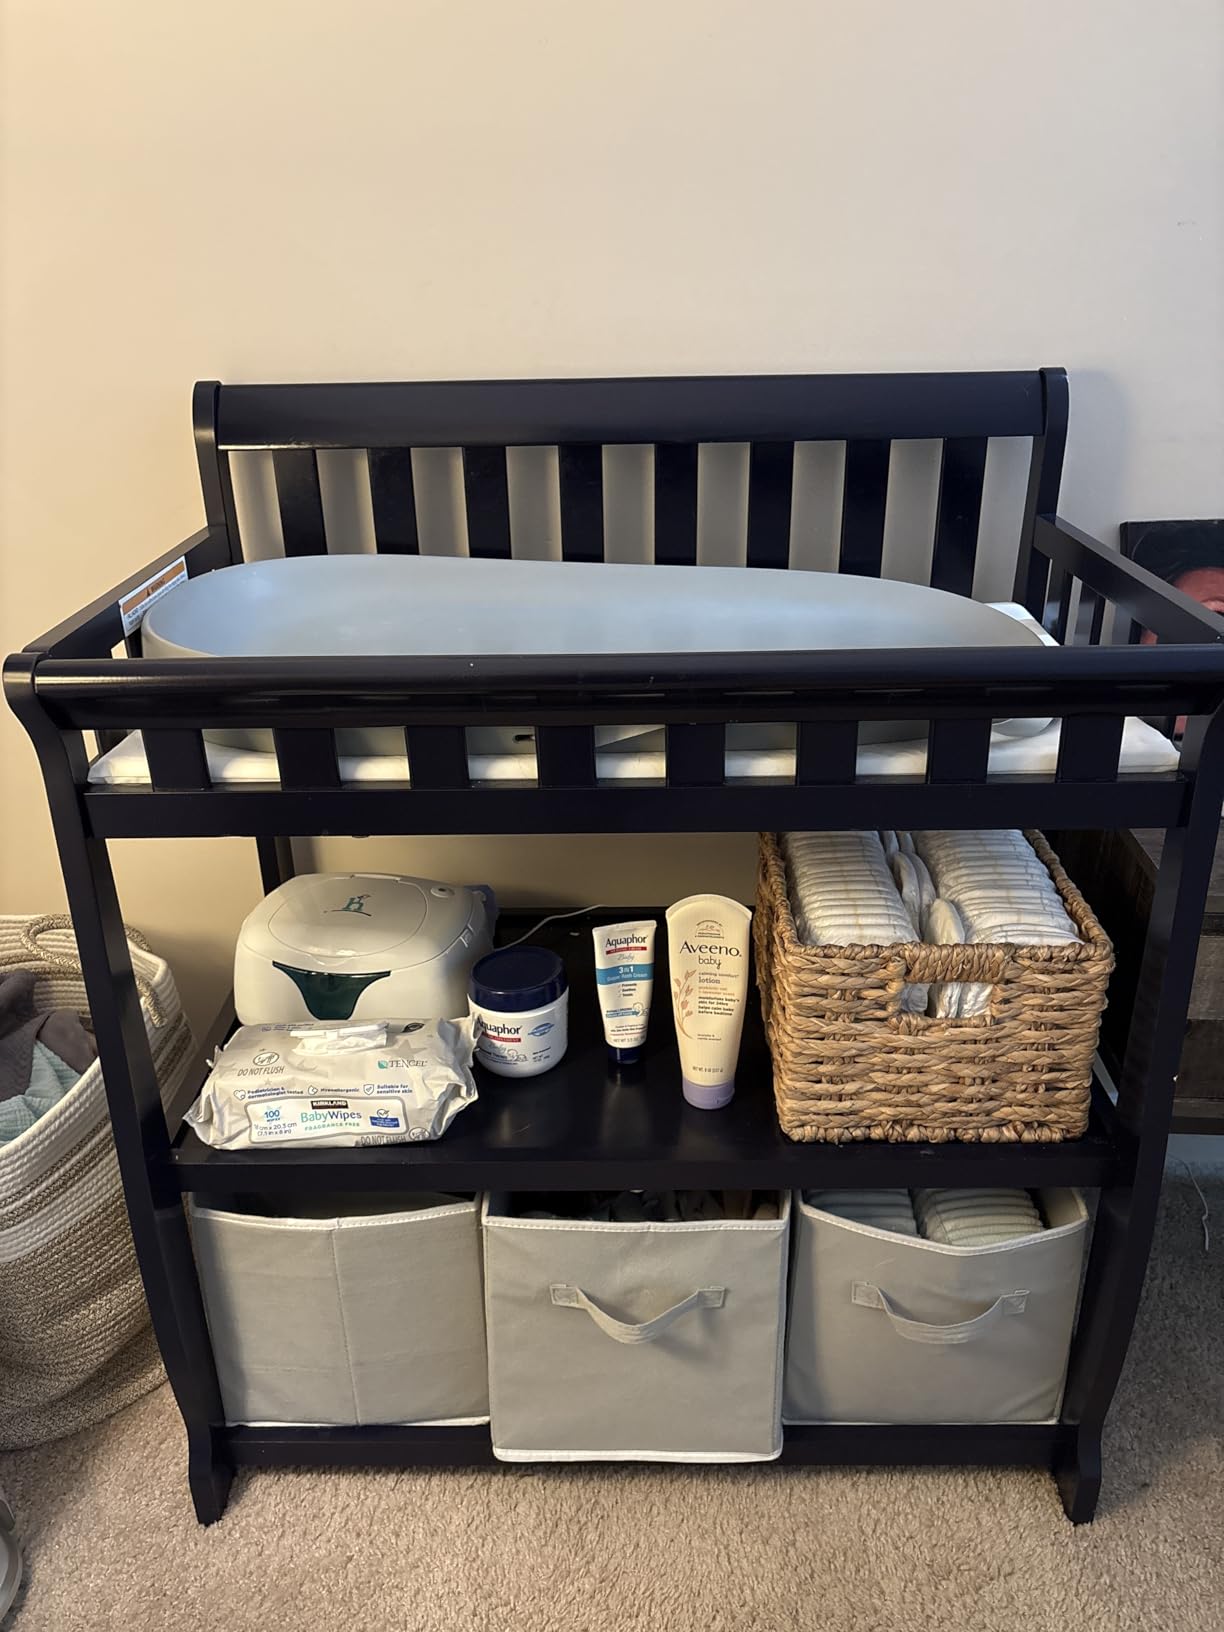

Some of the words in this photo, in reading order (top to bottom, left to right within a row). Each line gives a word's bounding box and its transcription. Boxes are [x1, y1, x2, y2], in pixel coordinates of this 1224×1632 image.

[606, 934, 647, 948] Aquaphor
[698, 956, 721, 969] baby
[698, 976, 721, 984] lotion
[482, 1022, 520, 1037] quaphor
[237, 1068, 249, 1077] DO
[249, 1067, 262, 1076] NOT
[263, 1066, 284, 1075] FLUSH
[264, 1110, 280, 1119] 100
[300, 1110, 362, 1123] BabyWipes
[360, 1135, 371, 1146] DO
[371, 1135, 384, 1145] NOT
